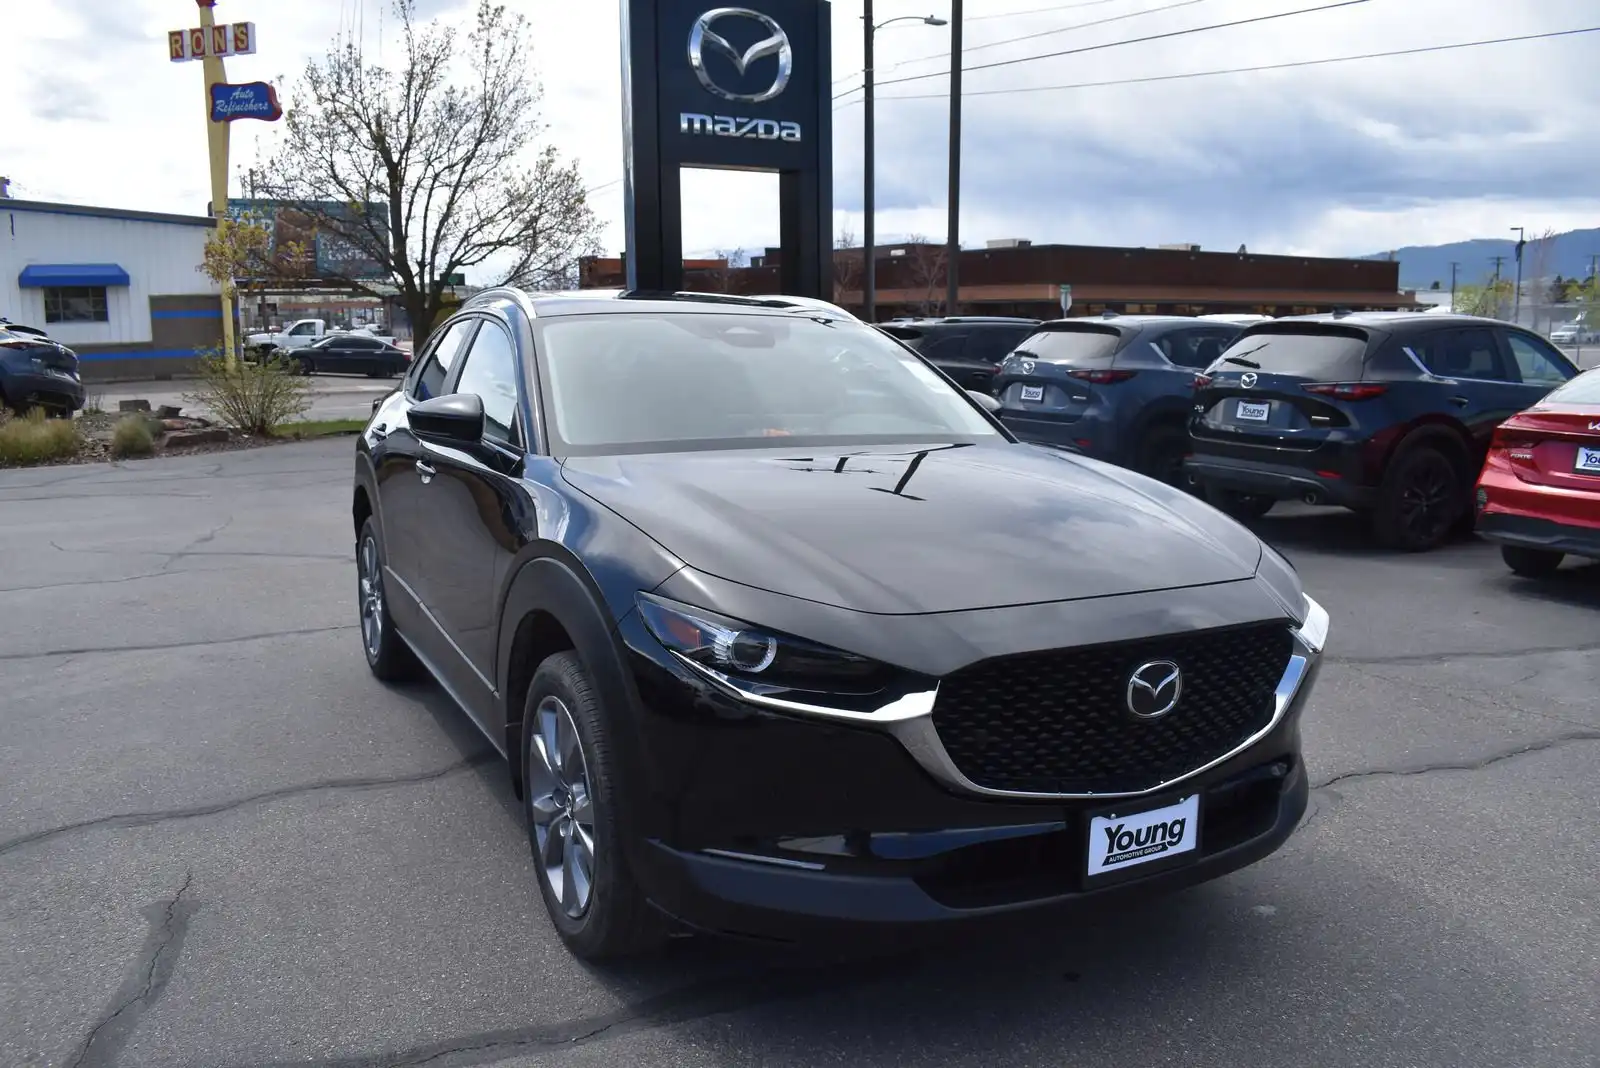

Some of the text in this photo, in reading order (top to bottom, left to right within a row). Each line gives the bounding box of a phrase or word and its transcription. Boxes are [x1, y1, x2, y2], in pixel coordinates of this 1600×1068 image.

[230, 86, 254, 100] Auto
[216, 99, 269, 116] Refinishers
[680, 112, 801, 142] mazda
[1241, 405, 1265, 418] Young
[1104, 818, 1187, 855] Young
[1108, 845, 1163, 864] AUTOMOTIVE GROUP
